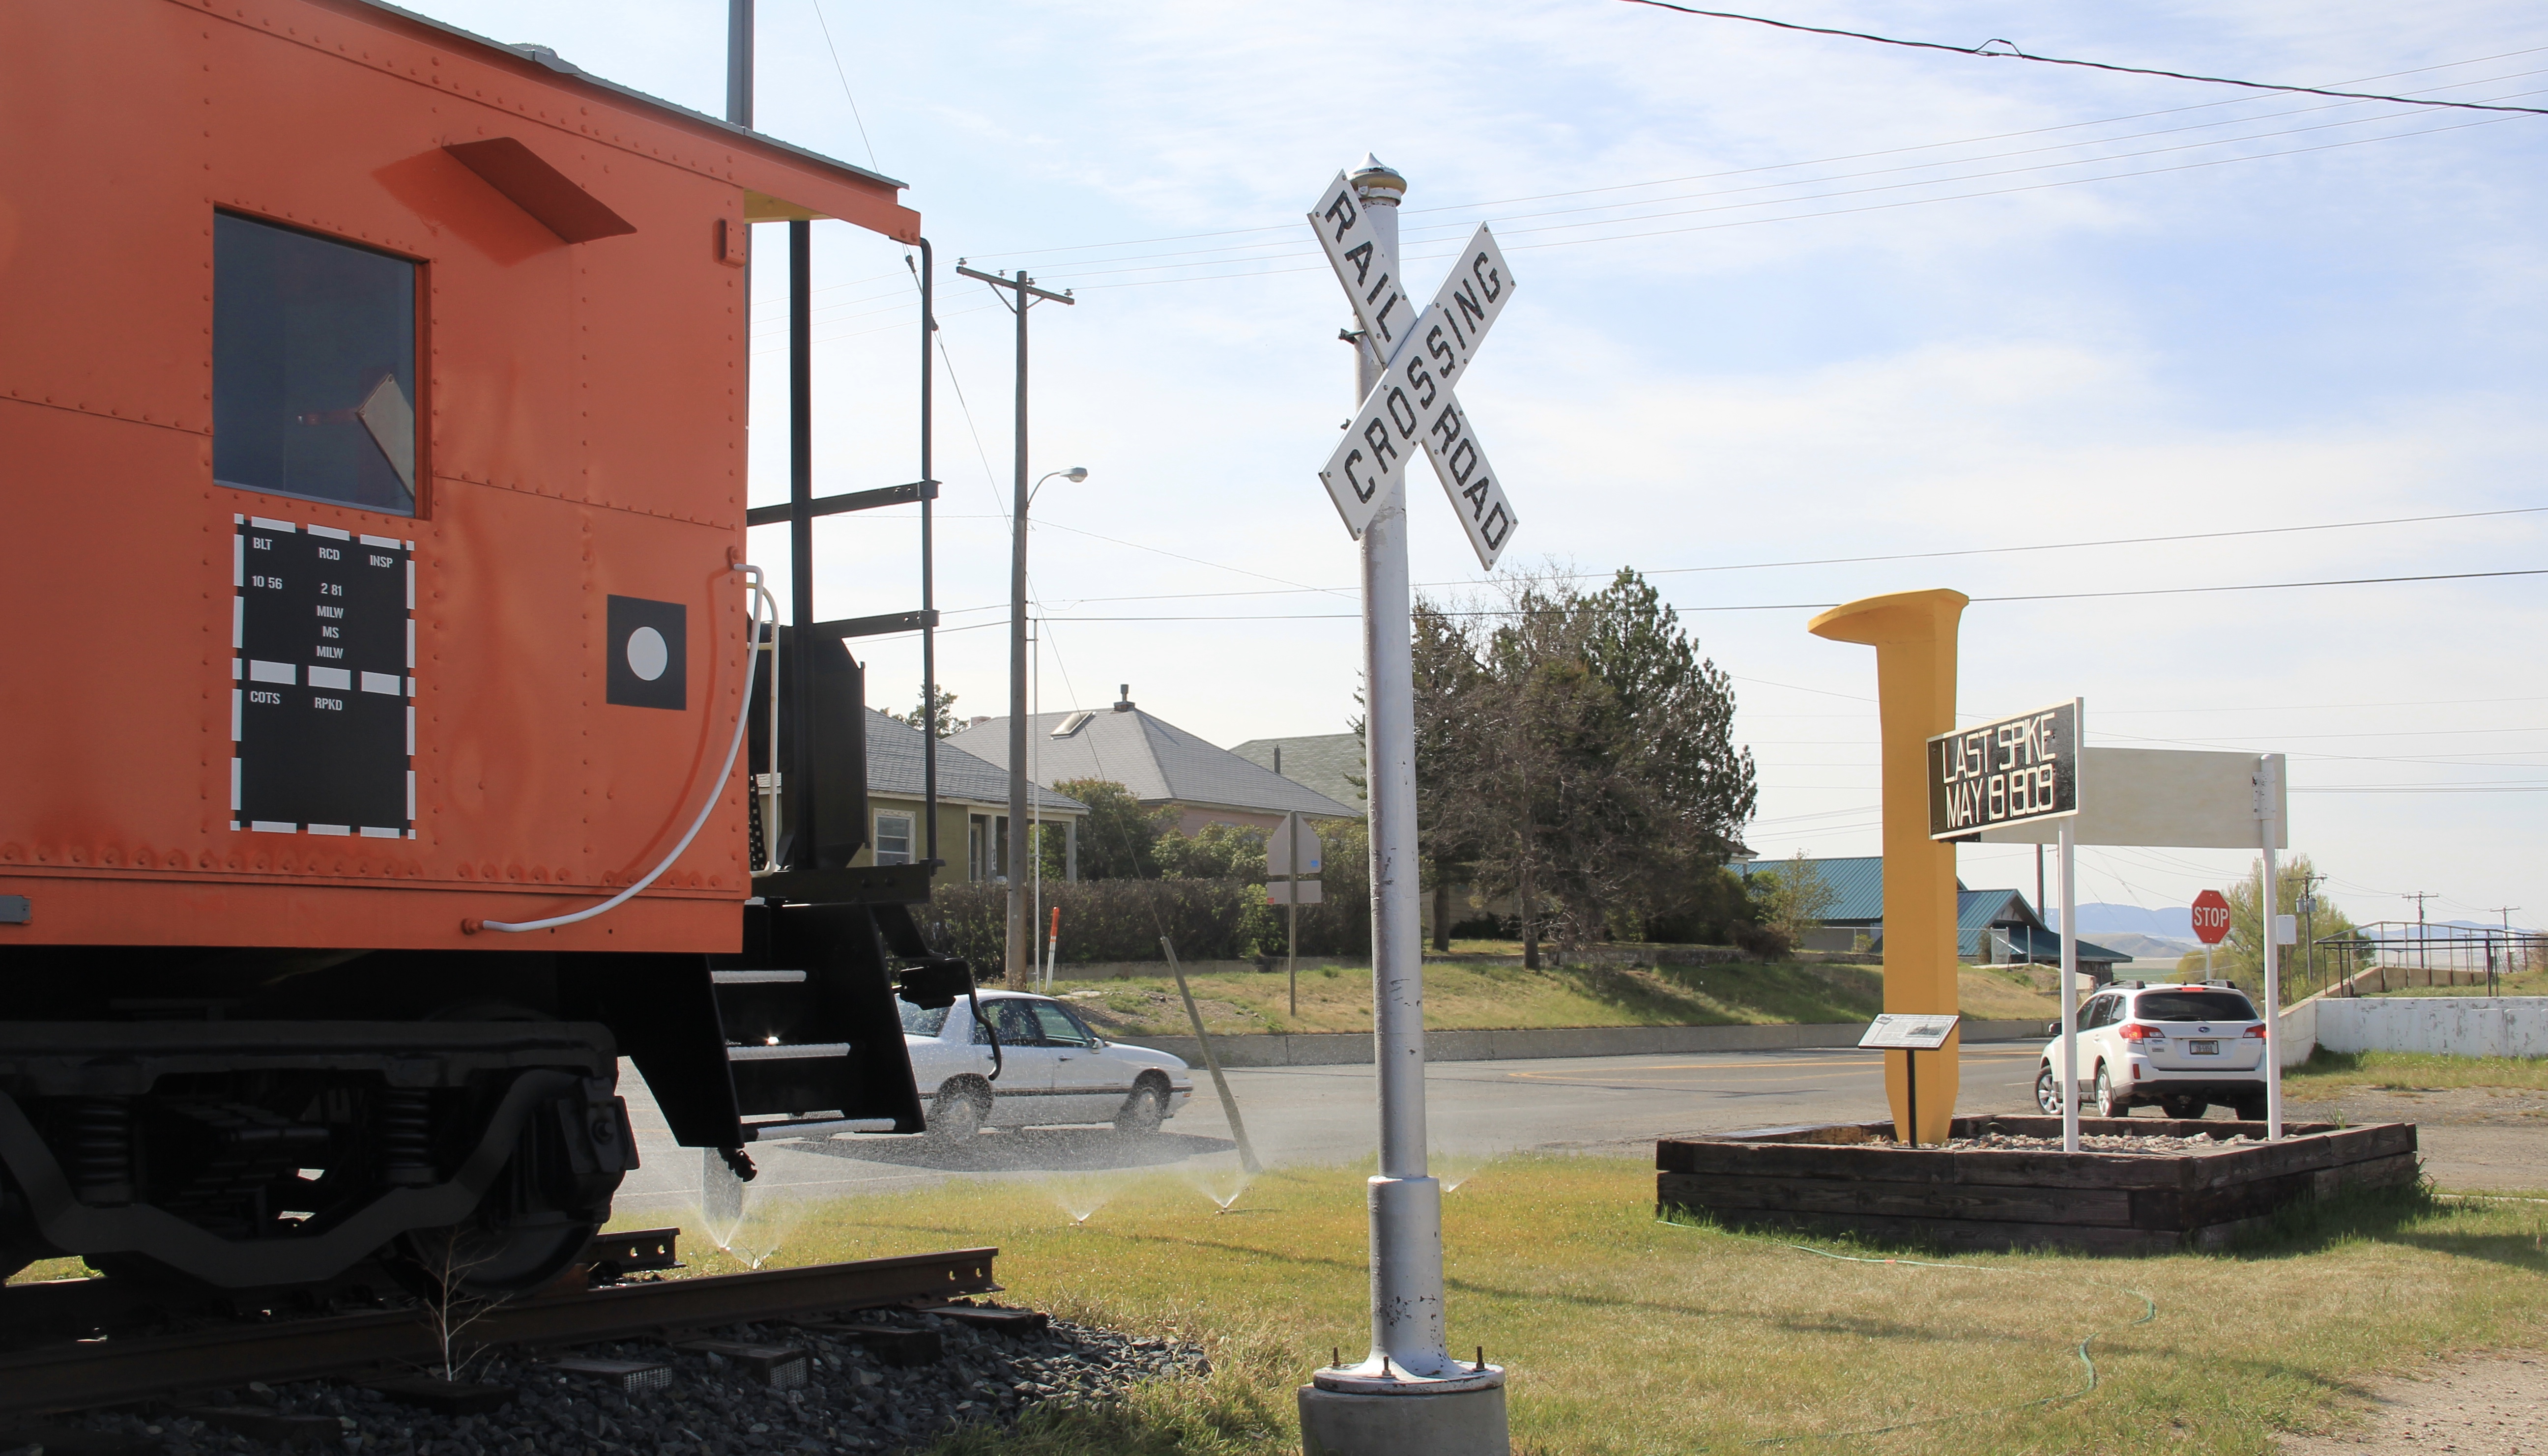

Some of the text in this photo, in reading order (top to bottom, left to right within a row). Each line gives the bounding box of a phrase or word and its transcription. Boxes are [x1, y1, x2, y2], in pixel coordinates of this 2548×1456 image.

[1325, 189, 1508, 551] RAIL ROAD
[1343, 251, 1501, 504] CROSSING
[253, 537, 273, 550] BLT
[318, 547, 340, 561] RCD
[370, 554, 393, 568] INSP
[252, 575, 283, 590] 10 56
[321, 582, 343, 597] 2 81
[317, 605, 344, 619] MILW
[322, 626, 339, 638] MS
[316, 645, 344, 659] MILW
[250, 690, 281, 705] COTS
[315, 697, 343, 711] RPKD
[1942, 712, 2056, 784] LAST SPIKE
[1946, 763, 2053, 828] MAY 19 1909
[2194, 906, 2229, 928] STOP
